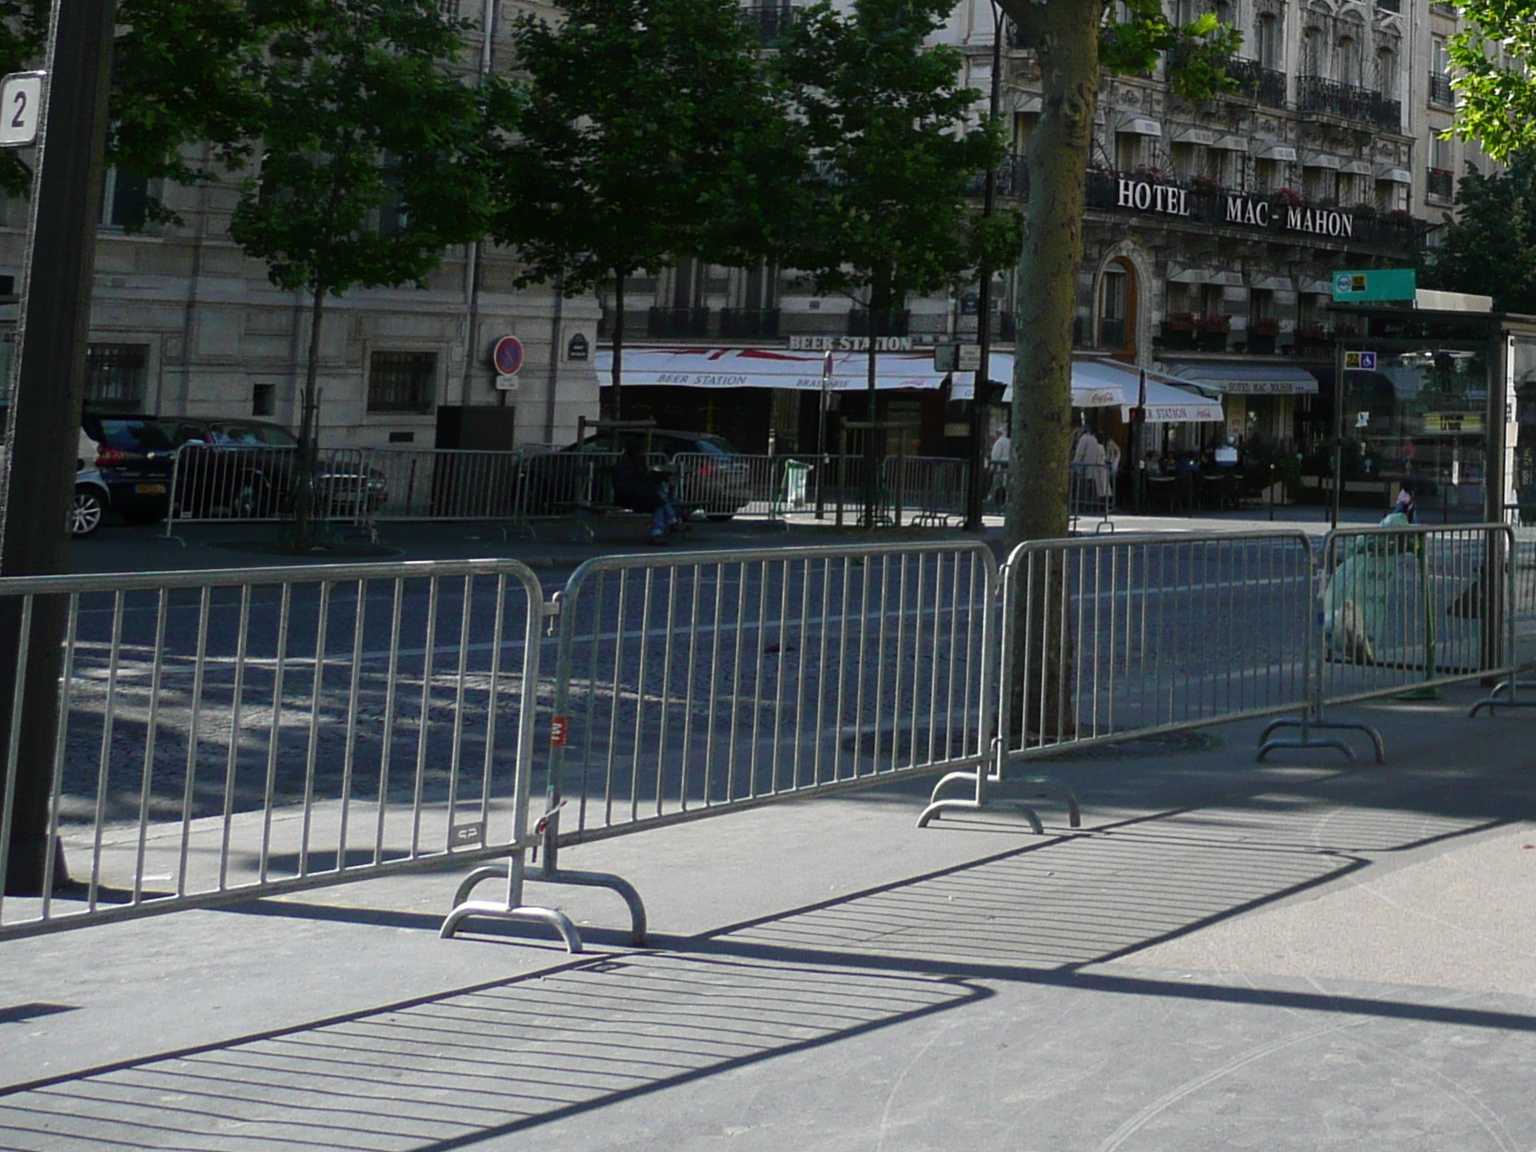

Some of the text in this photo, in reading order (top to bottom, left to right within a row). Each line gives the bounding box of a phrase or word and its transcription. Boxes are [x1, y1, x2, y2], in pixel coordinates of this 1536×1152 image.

[12, 91, 27, 128] 2
[1117, 178, 1191, 216] HOTEL
[1287, 205, 1353, 237] MAHON
[789, 335, 912, 351] BEER STATION
[657, 373, 747, 386] BEER STATION
[1156, 407, 1188, 419] STATION
